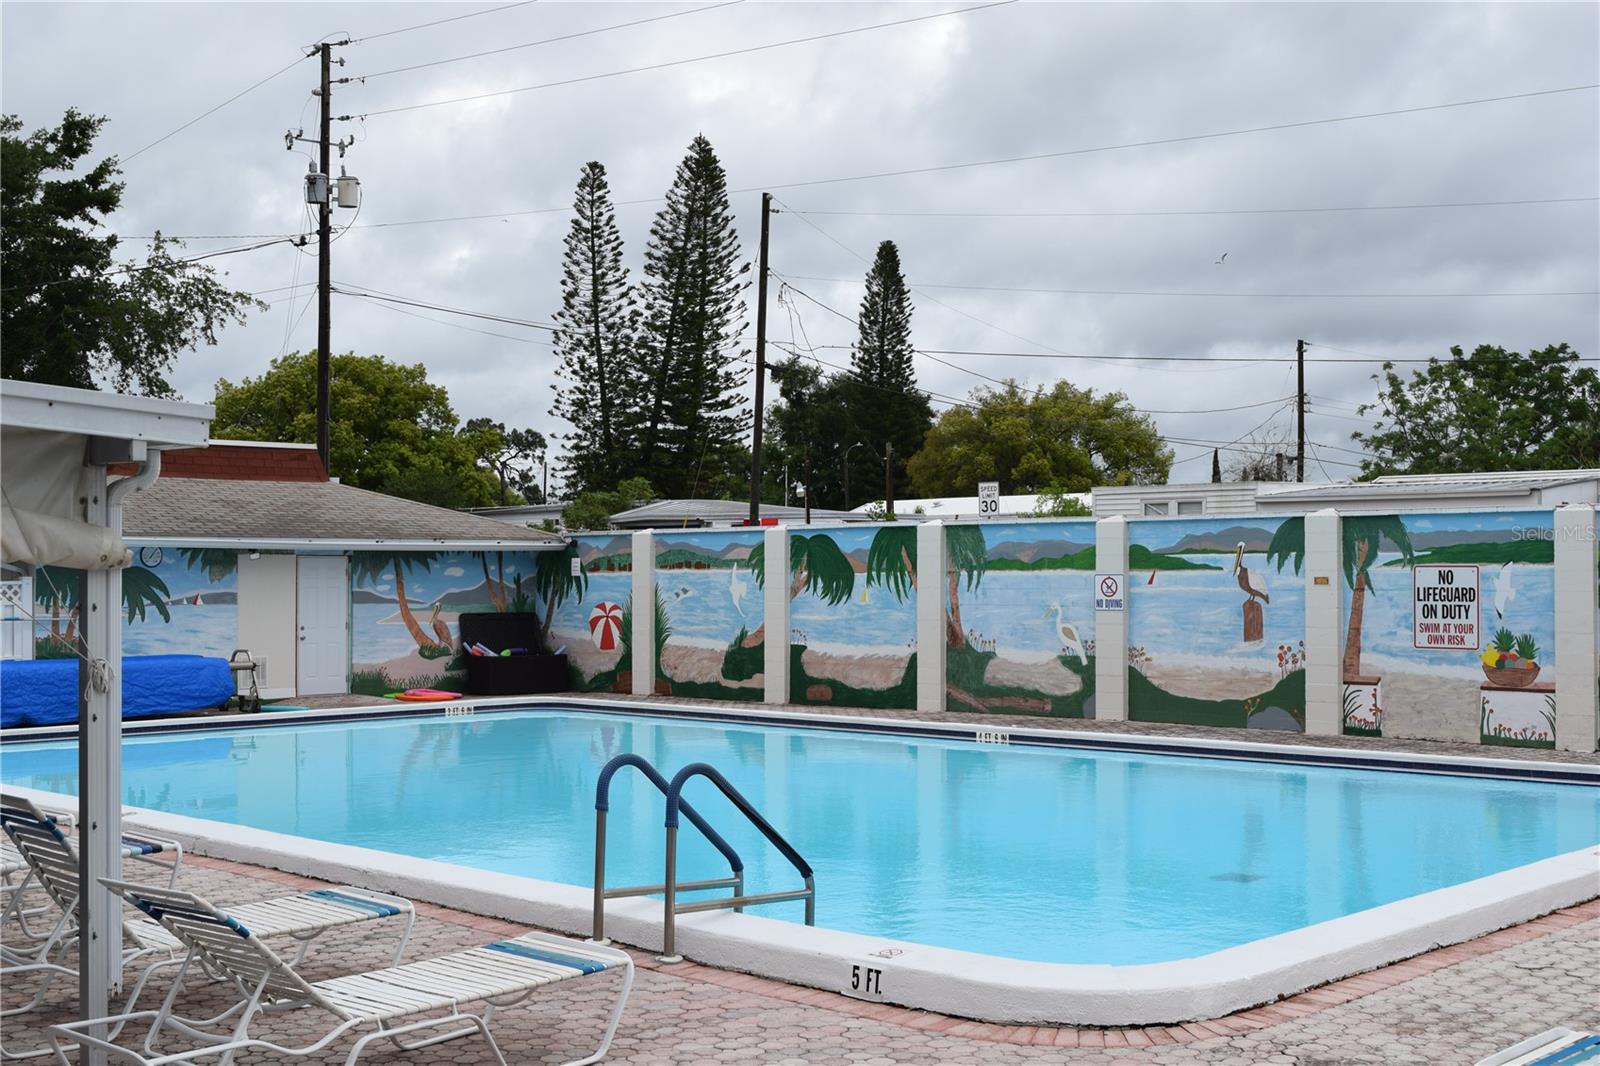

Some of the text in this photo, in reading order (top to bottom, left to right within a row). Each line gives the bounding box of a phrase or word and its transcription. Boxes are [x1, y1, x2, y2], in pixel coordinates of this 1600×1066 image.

[981, 500, 998, 513] 30
[1438, 569, 1454, 585] NO
[1417, 587, 1476, 602] LIFEGUARD
[1096, 599, 1123, 608] NO DIVING
[1422, 604, 1471, 620] ON DUTY
[1419, 622, 1474, 635] SWIM AT YOUR
[1427, 634, 1466, 646] OWN RISK
[851, 964, 882, 995] 5 FT.
